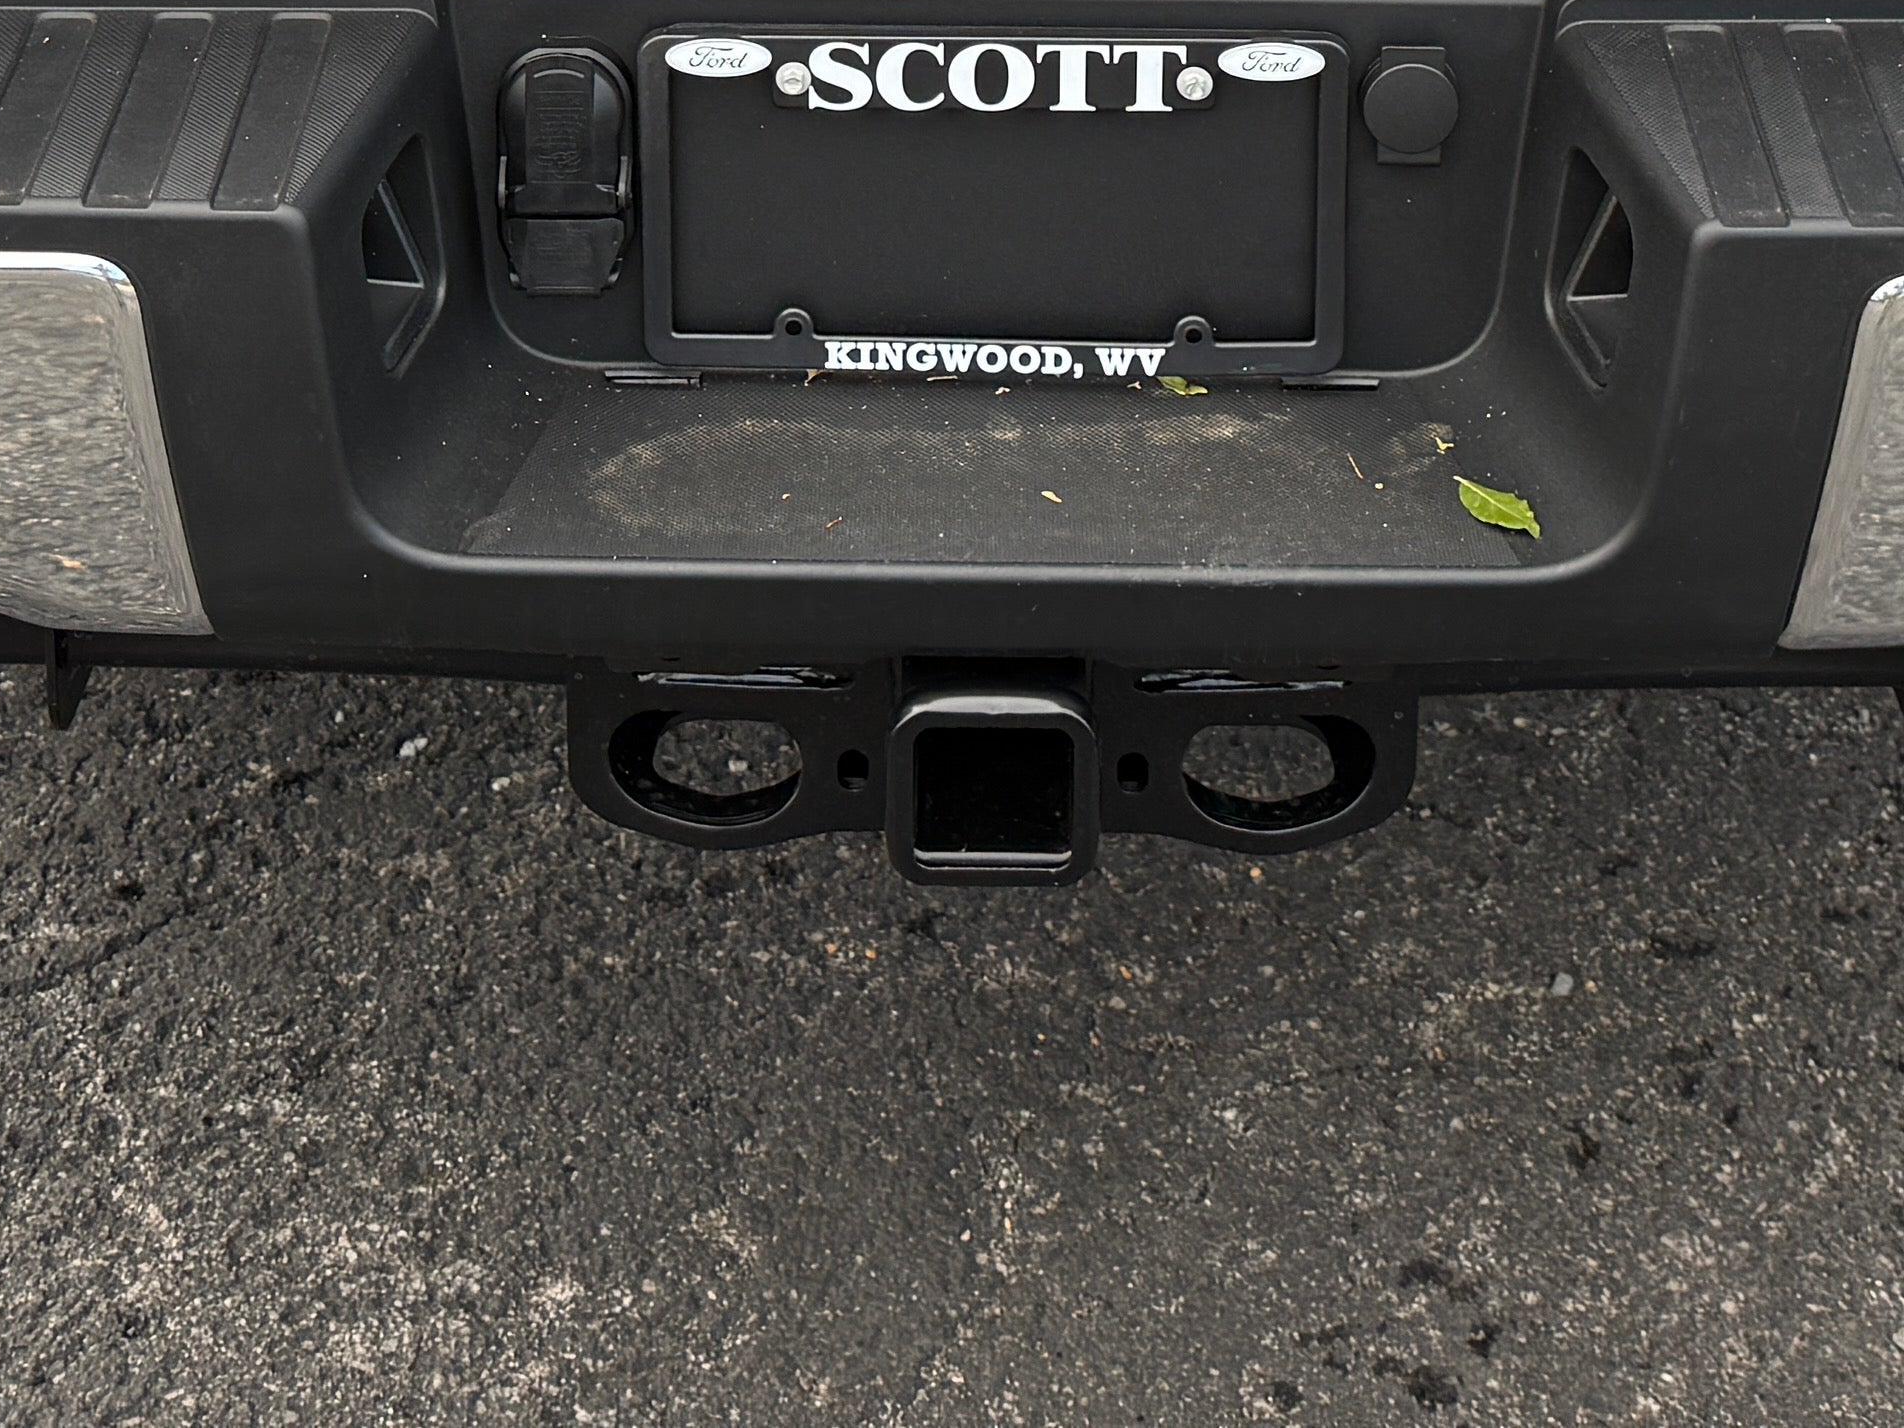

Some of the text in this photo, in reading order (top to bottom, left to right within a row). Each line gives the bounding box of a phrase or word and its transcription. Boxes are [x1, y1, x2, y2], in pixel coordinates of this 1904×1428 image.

[688, 45, 749, 69] Ford
[1241, 49, 1302, 73] Ford
[807, 41, 1188, 113] SCOTT
[823, 341, 1167, 380] KINGWOOD, WV
